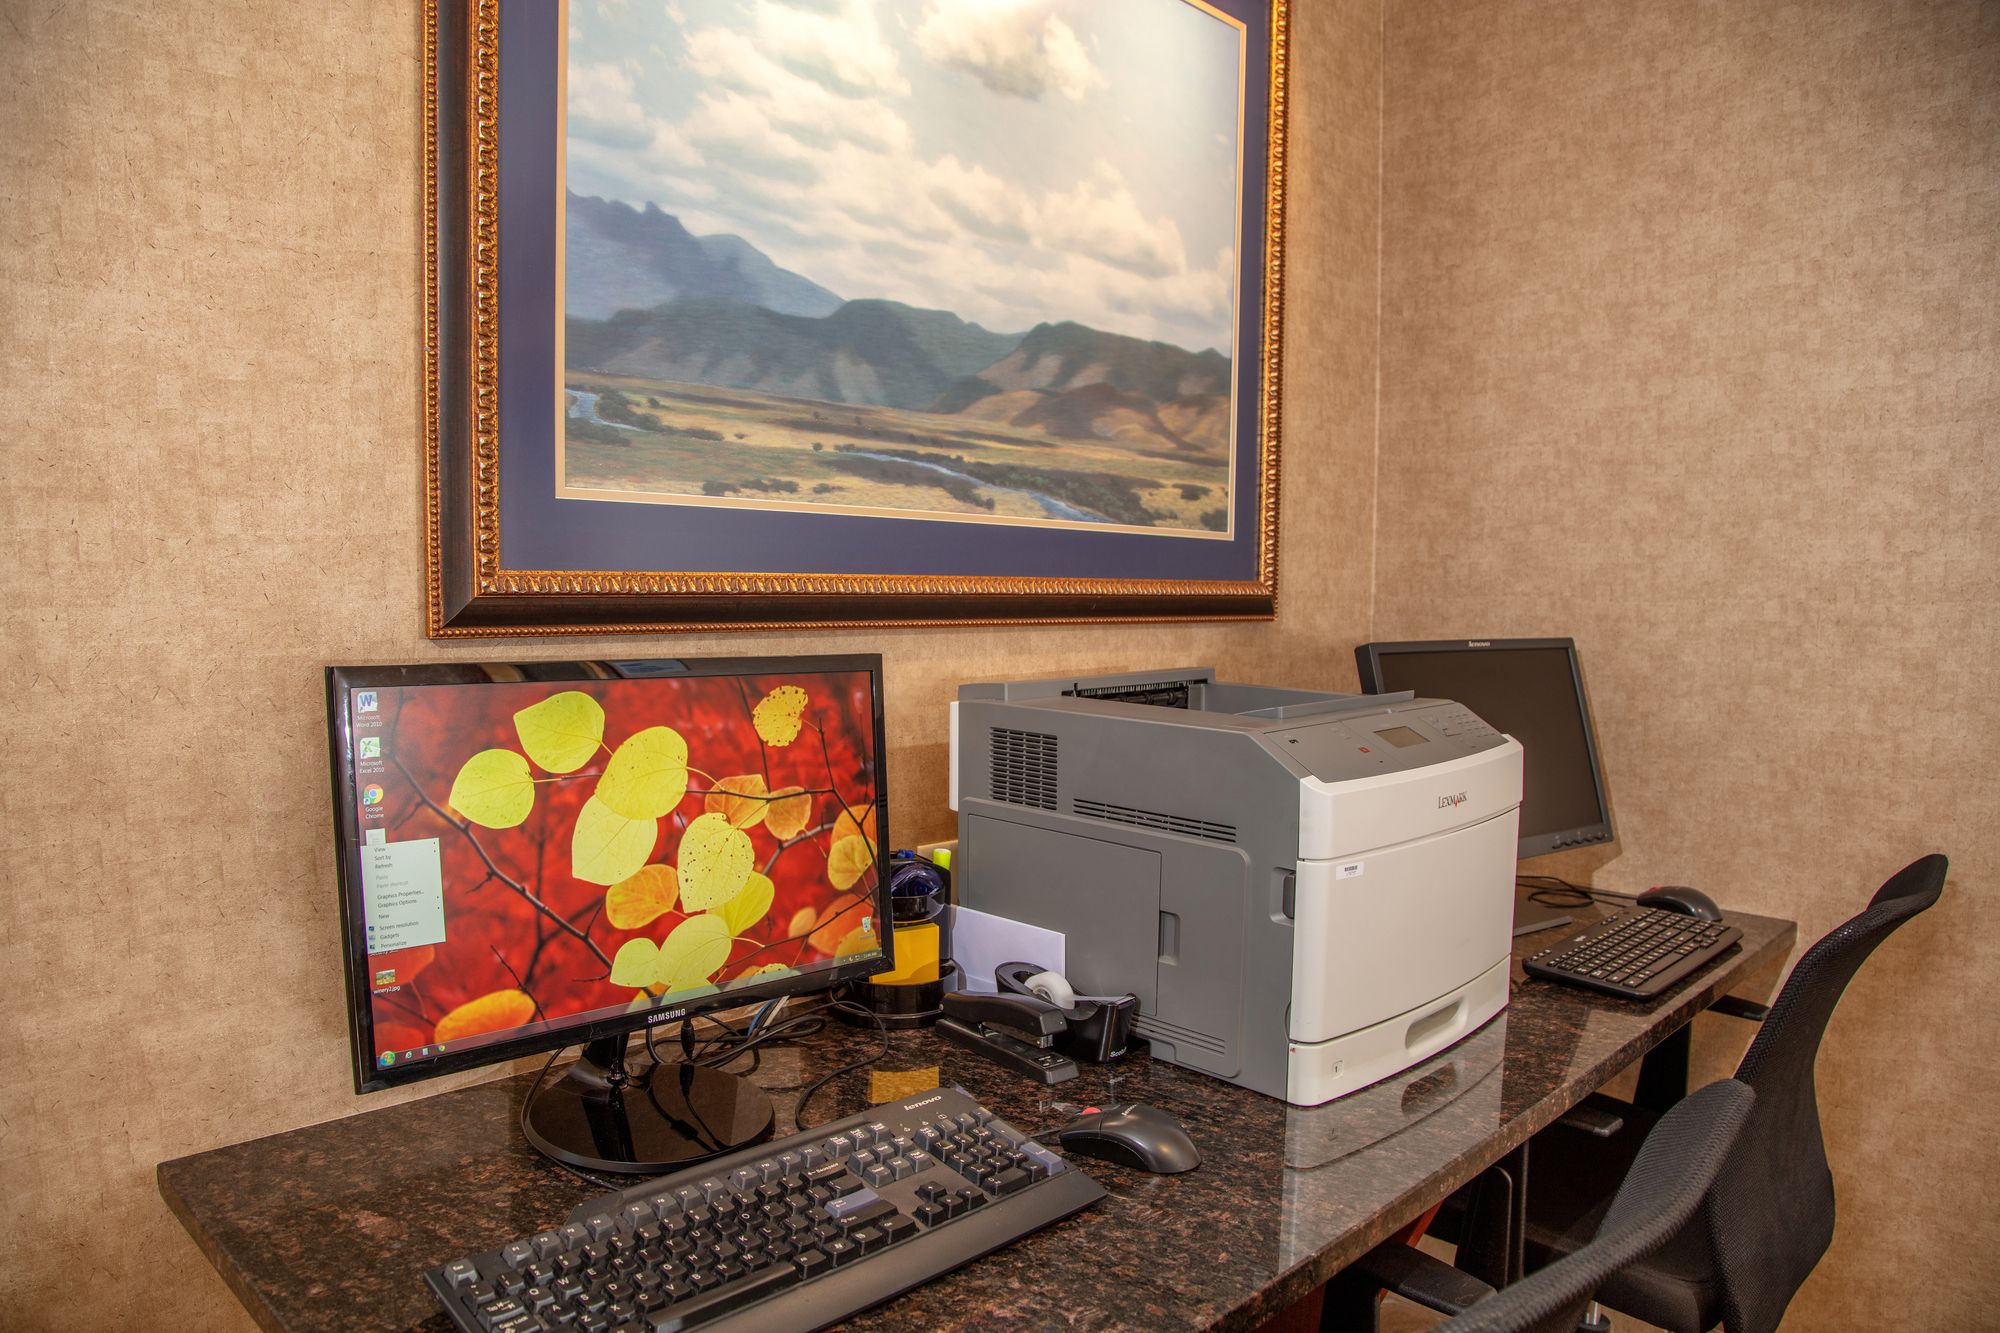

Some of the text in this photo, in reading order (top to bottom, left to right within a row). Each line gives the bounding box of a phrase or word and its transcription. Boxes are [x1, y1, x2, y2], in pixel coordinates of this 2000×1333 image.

[360, 695, 372, 706] W
[1438, 791, 1468, 808] LEXMARK
[648, 1008, 686, 1023] SAMSUNG
[904, 1096, 941, 1110] lenovo
